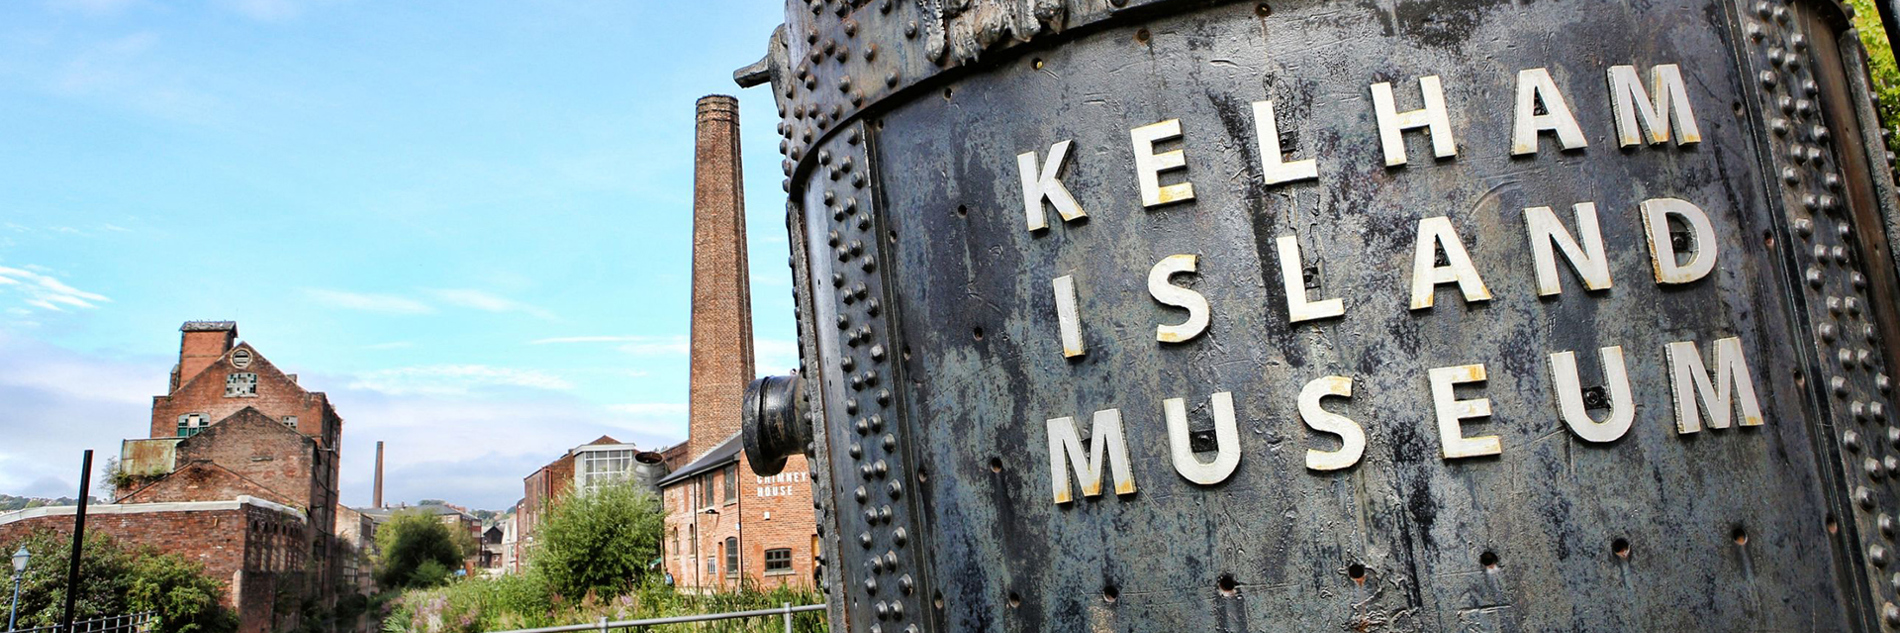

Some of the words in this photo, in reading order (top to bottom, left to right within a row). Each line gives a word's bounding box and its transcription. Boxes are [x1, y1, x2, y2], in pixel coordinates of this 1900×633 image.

[1016, 63, 1702, 232] KELHAM
[1052, 197, 1717, 358] ISLAND
[757, 471, 807, 484] CHIMNEY
[757, 486, 793, 497] HOUSE
[1047, 335, 1763, 505] MUSEUM
